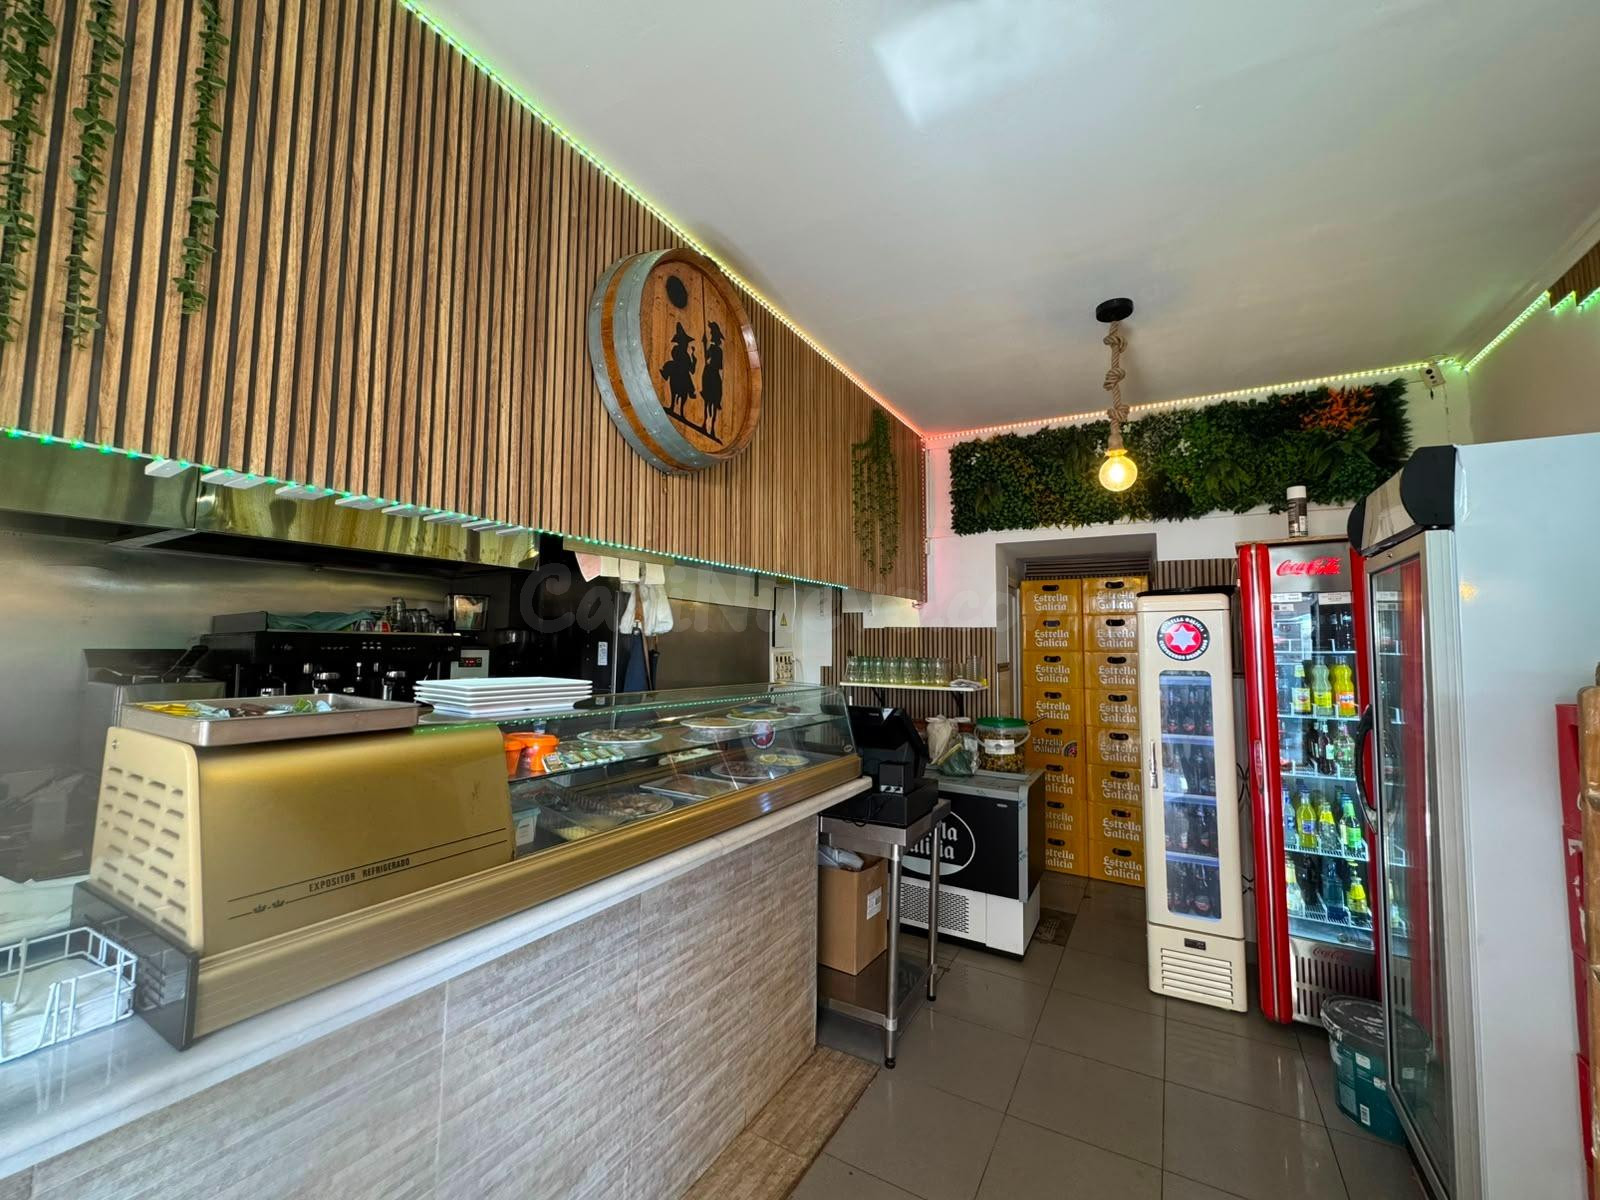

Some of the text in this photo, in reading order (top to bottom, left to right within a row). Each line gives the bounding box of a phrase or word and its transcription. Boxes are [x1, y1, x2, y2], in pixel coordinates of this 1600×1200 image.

[1033, 593, 1068, 602] Estrella
[1034, 602, 1067, 611] Galicia
[1034, 629, 1069, 638] Estrella
[1035, 638, 1068, 647] Galicia
[1098, 638, 1133, 647] Galicia
[1035, 664, 1070, 674] Estrella
[1098, 665, 1136, 675] Estrella
[1036, 673, 1069, 683] Galicia
[1100, 674, 1135, 685] Galicia
[1035, 701, 1071, 710] Estrella
[1099, 702, 1137, 713] Estrella
[1036, 710, 1069, 720] Galicia
[1100, 712, 1136, 723] Galicia
[1100, 742, 1138, 753] Estrella
[1101, 752, 1137, 763] Galicia
[1045, 773, 1075, 784] trella
[1045, 783, 1073, 794] alicia
[1102, 778, 1140, 791] Estrella
[1103, 789, 1139, 800] Galicia
[1045, 811, 1074, 822] strella
[1046, 820, 1072, 831] alicia
[1103, 818, 1141, 832] Estrella
[1103, 827, 1140, 841] Galicia
[1045, 848, 1075, 860] strella
[1045, 857, 1073, 869] alicia
[1103, 855, 1142, 871] Estrella
[309, 857, 410, 892] EXPOSITOR REFRIGERADO
[1104, 865, 1140, 881] Galicia
